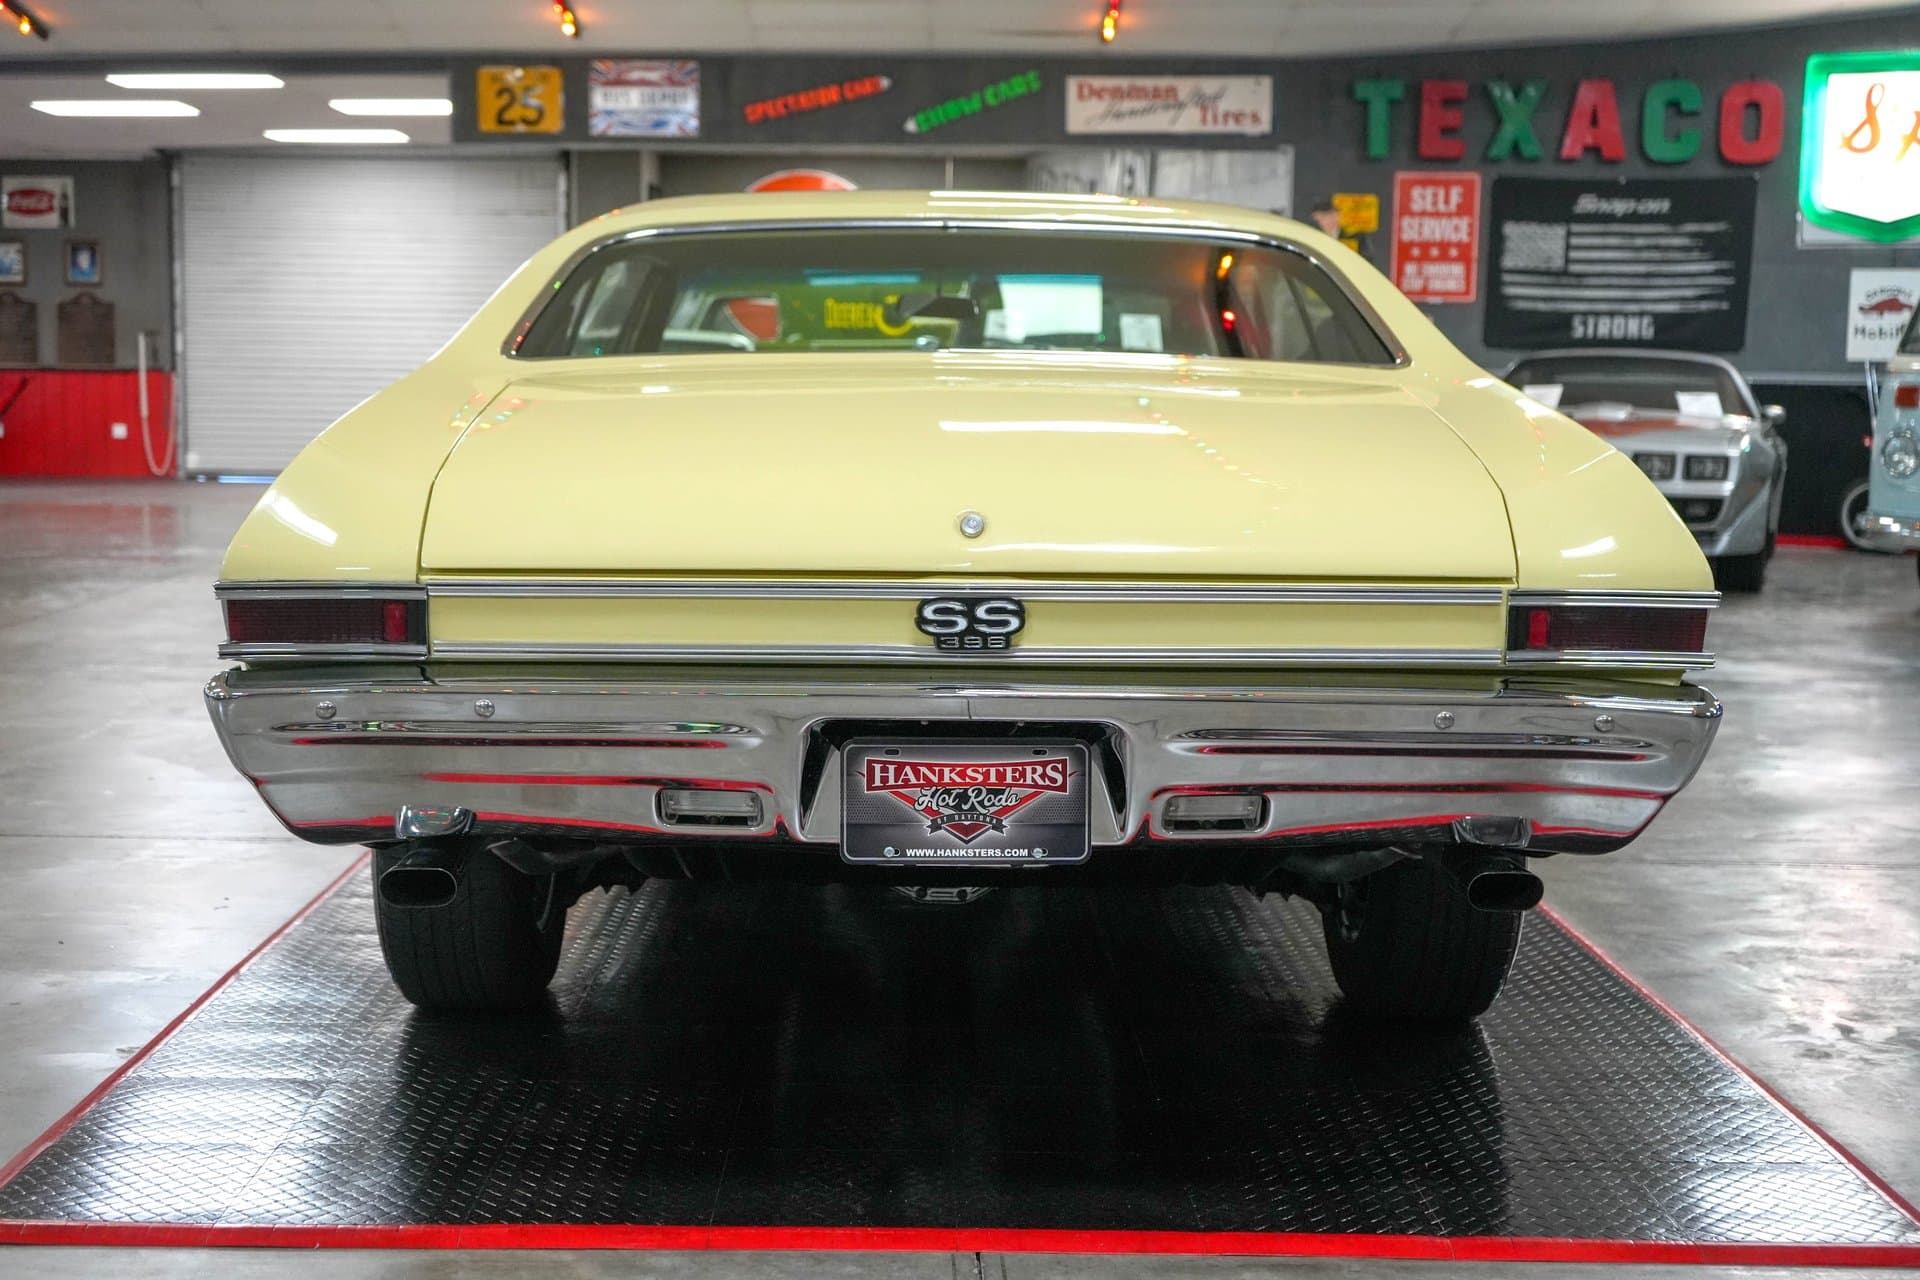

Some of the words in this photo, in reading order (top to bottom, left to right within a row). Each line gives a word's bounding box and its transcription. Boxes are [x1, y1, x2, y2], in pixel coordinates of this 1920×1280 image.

[983, 69, 1041, 107] CARS
[496, 87, 545, 127] 25
[1200, 105, 1262, 127] Tires
[1354, 79, 1784, 164] TEXACO
[1410, 185, 1464, 213] SELF
[1401, 216, 1471, 243] SERVICE
[1572, 315, 1655, 340] STRONG
[921, 600, 1021, 633] SS
[940, 636, 1006, 648] 396
[872, 763, 1064, 787] HANKSTERS
[915, 786, 960, 811] Hot
[961, 786, 1021, 814] Rods
[954, 814, 996, 824] DAYTONA
[906, 848, 1028, 857] WWW.HANKSTERS.COM
